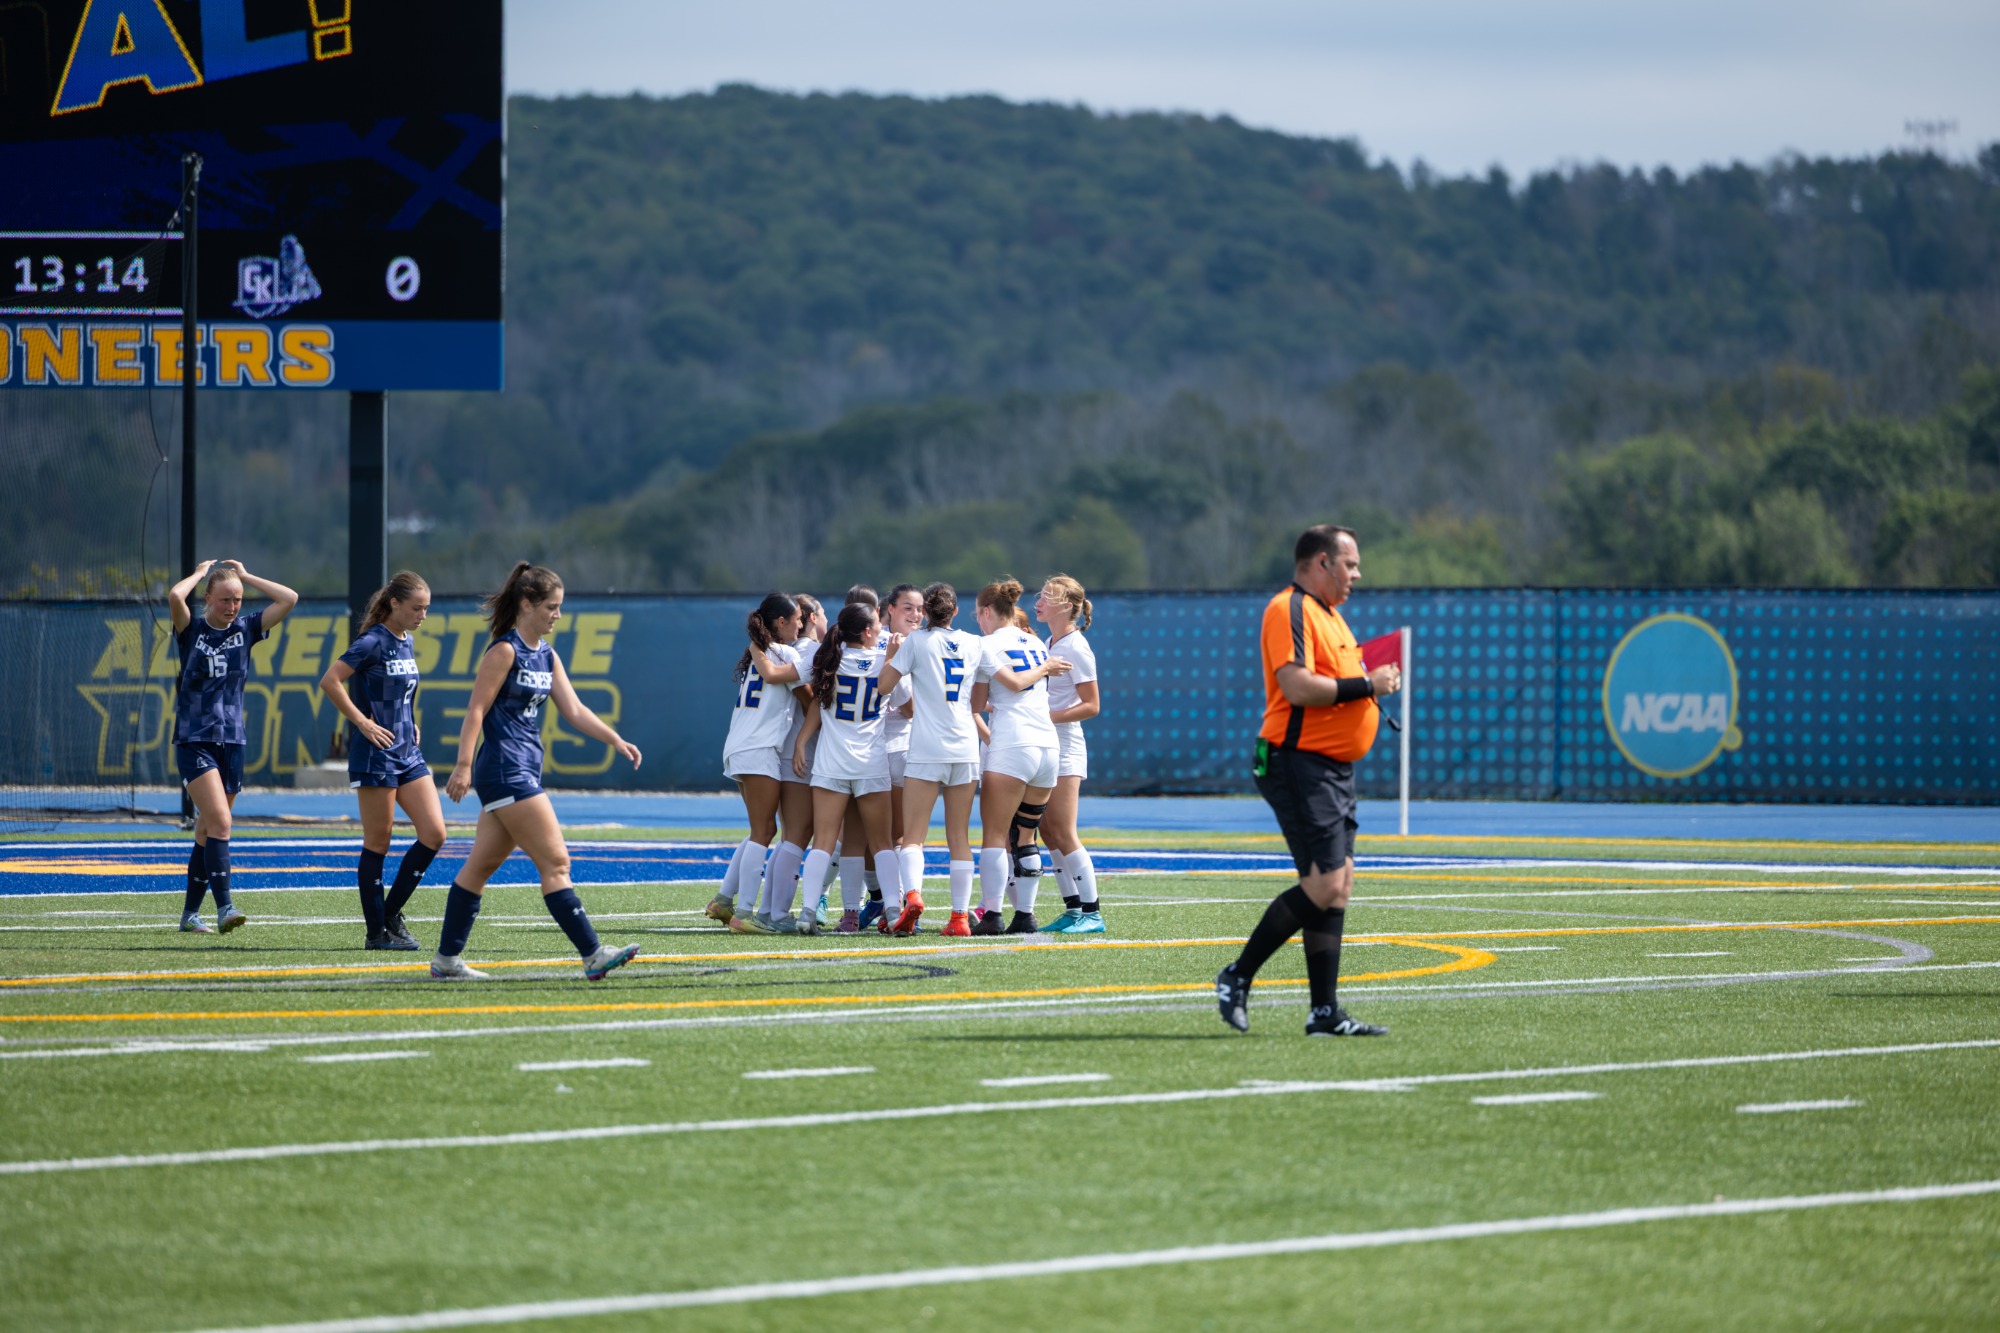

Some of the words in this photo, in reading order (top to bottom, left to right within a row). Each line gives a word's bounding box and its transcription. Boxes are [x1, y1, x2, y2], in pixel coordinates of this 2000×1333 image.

[14, 256, 149, 293] 13:14
[385, 256, 421, 301] 0
[0, 322, 336, 387] NEERS
[92, 615, 350, 678] ALRE
[405, 612, 623, 675] STE
[206, 654, 228, 678] 15
[403, 679, 417, 705] 2
[834, 673, 883, 722] 20
[941, 656, 965, 702] 5
[1620, 692, 1728, 733] NCAA
